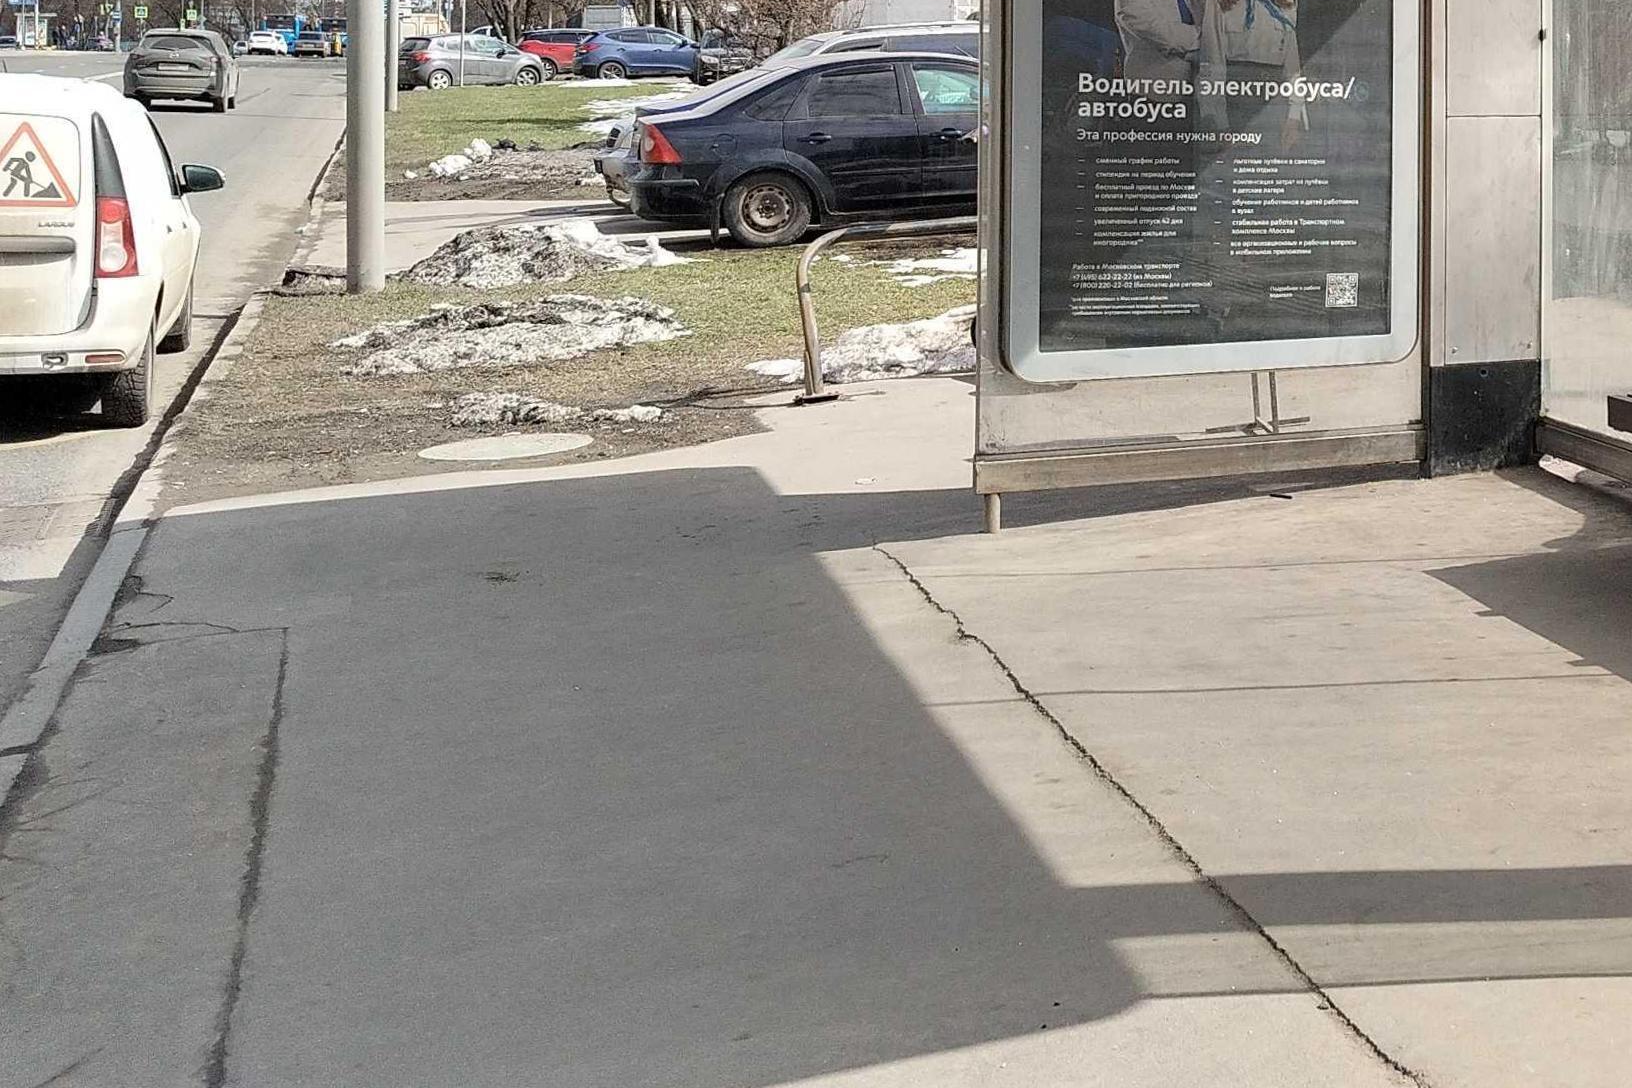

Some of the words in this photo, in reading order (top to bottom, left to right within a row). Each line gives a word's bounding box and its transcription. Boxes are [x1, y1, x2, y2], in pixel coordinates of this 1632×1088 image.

[1078, 72, 1194, 97] Водитель
[1200, 76, 1355, 101] электробуса/
[1078, 98, 1187, 123] автобуса
[1077, 128, 1100, 142] Эта
[1103, 129, 1173, 144] профессия
[1176, 131, 1216, 145] нужна
[1219, 131, 1262, 145] городу
[1154, 157, 1180, 165] работы
